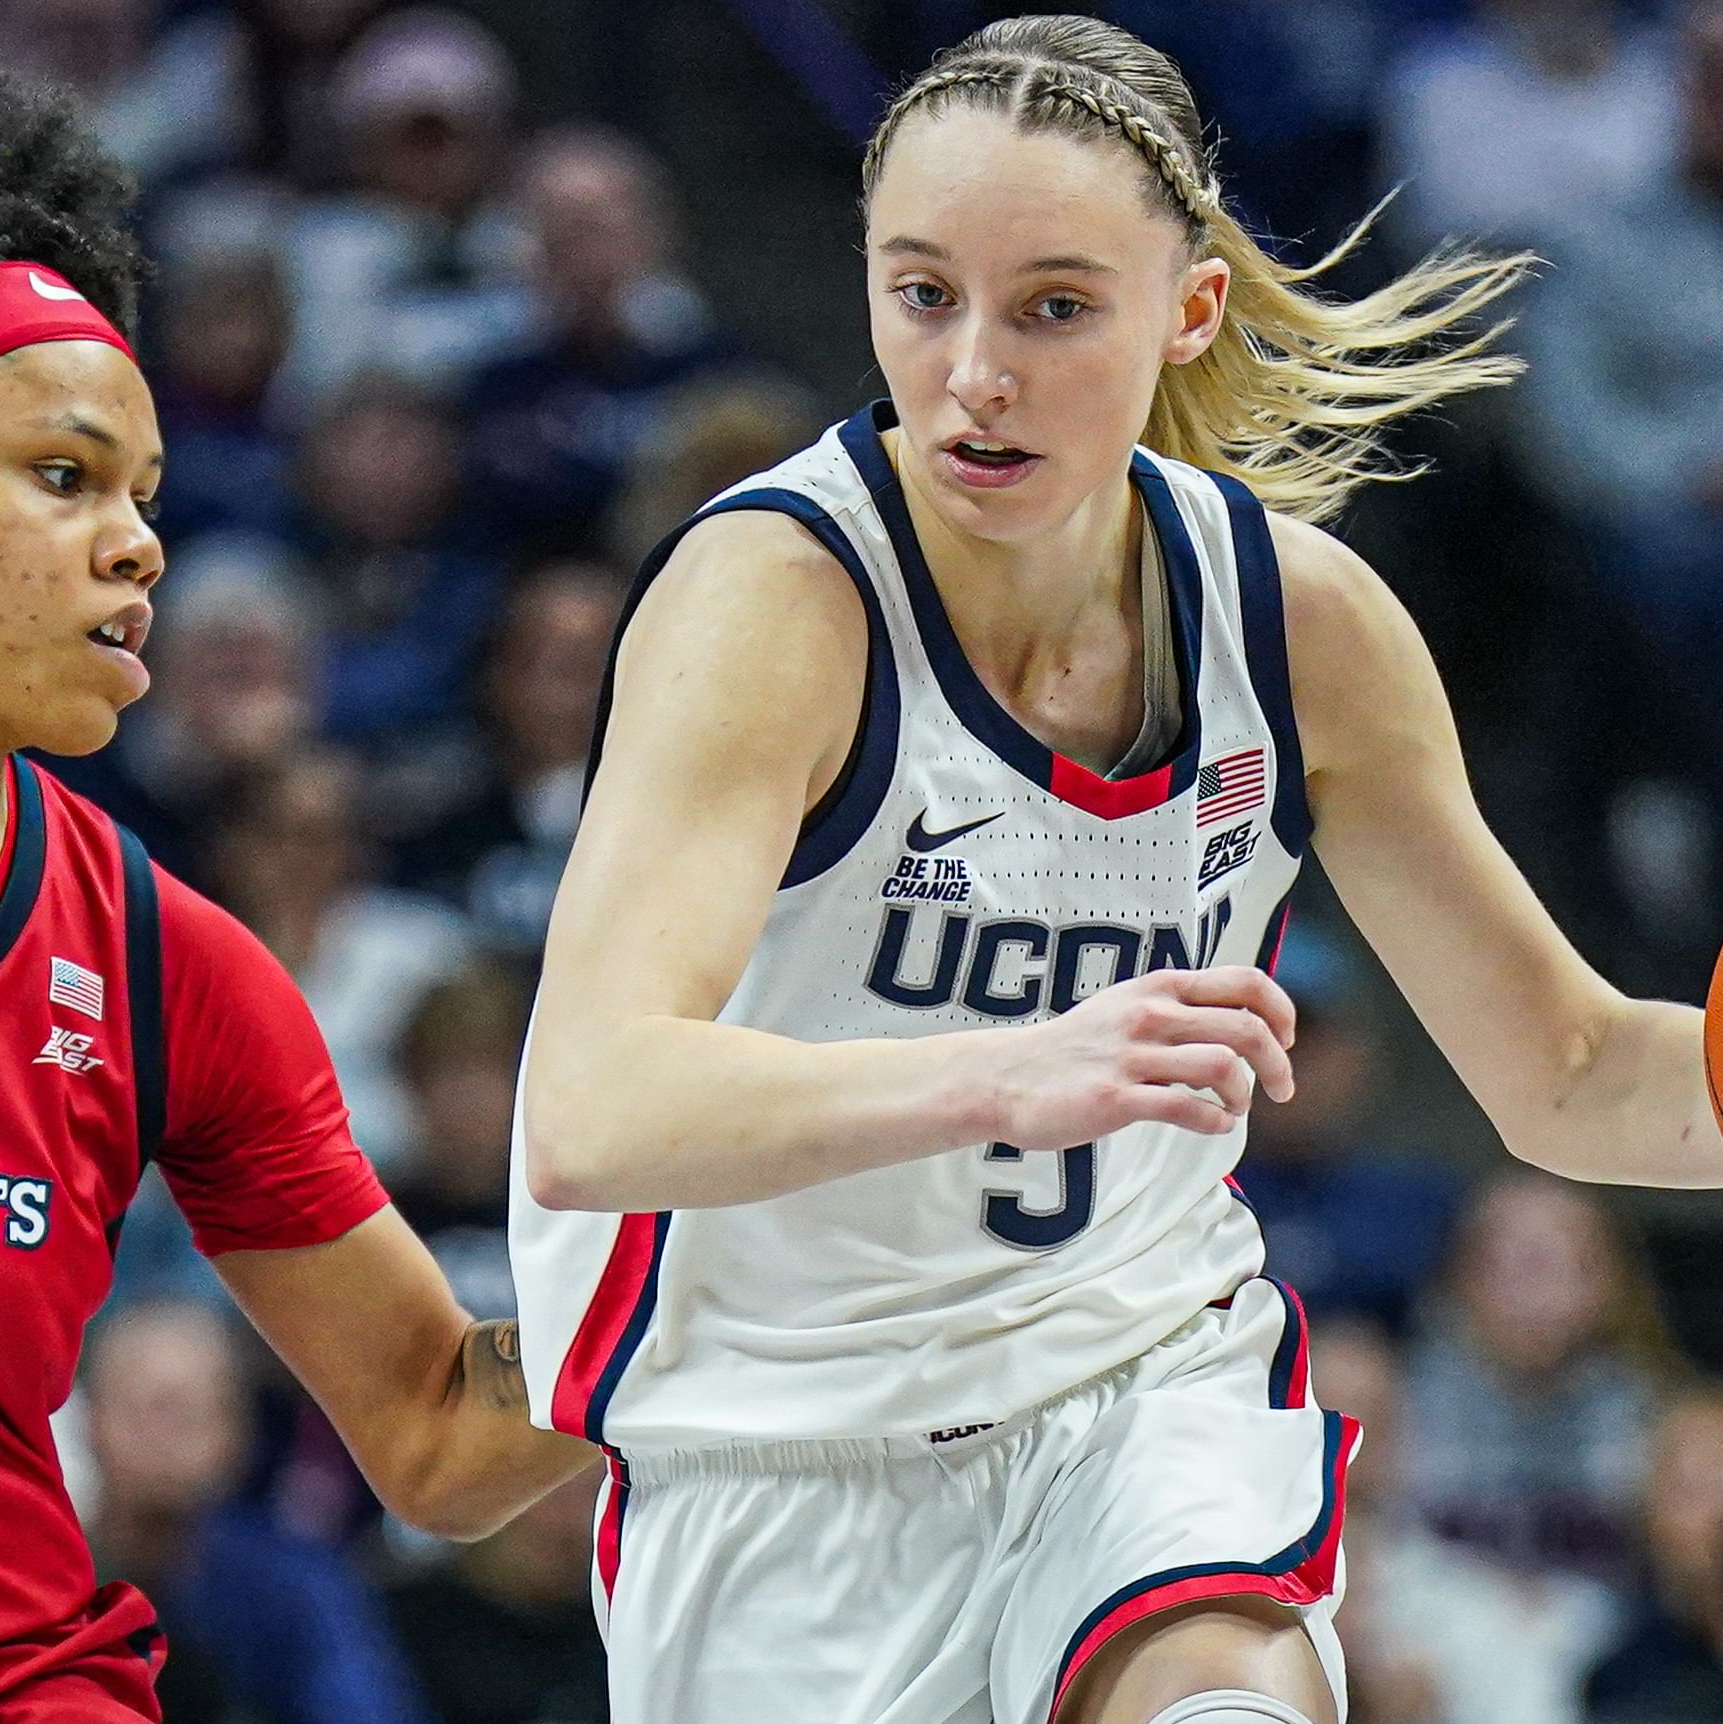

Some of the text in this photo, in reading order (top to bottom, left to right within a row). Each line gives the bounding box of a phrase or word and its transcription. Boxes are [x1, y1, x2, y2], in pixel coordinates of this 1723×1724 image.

[1204, 819, 1254, 859] BIG
[895, 855, 967, 880] BE THE
[1198, 831, 1262, 881] EAST
[881, 877, 972, 902] CHANGE
